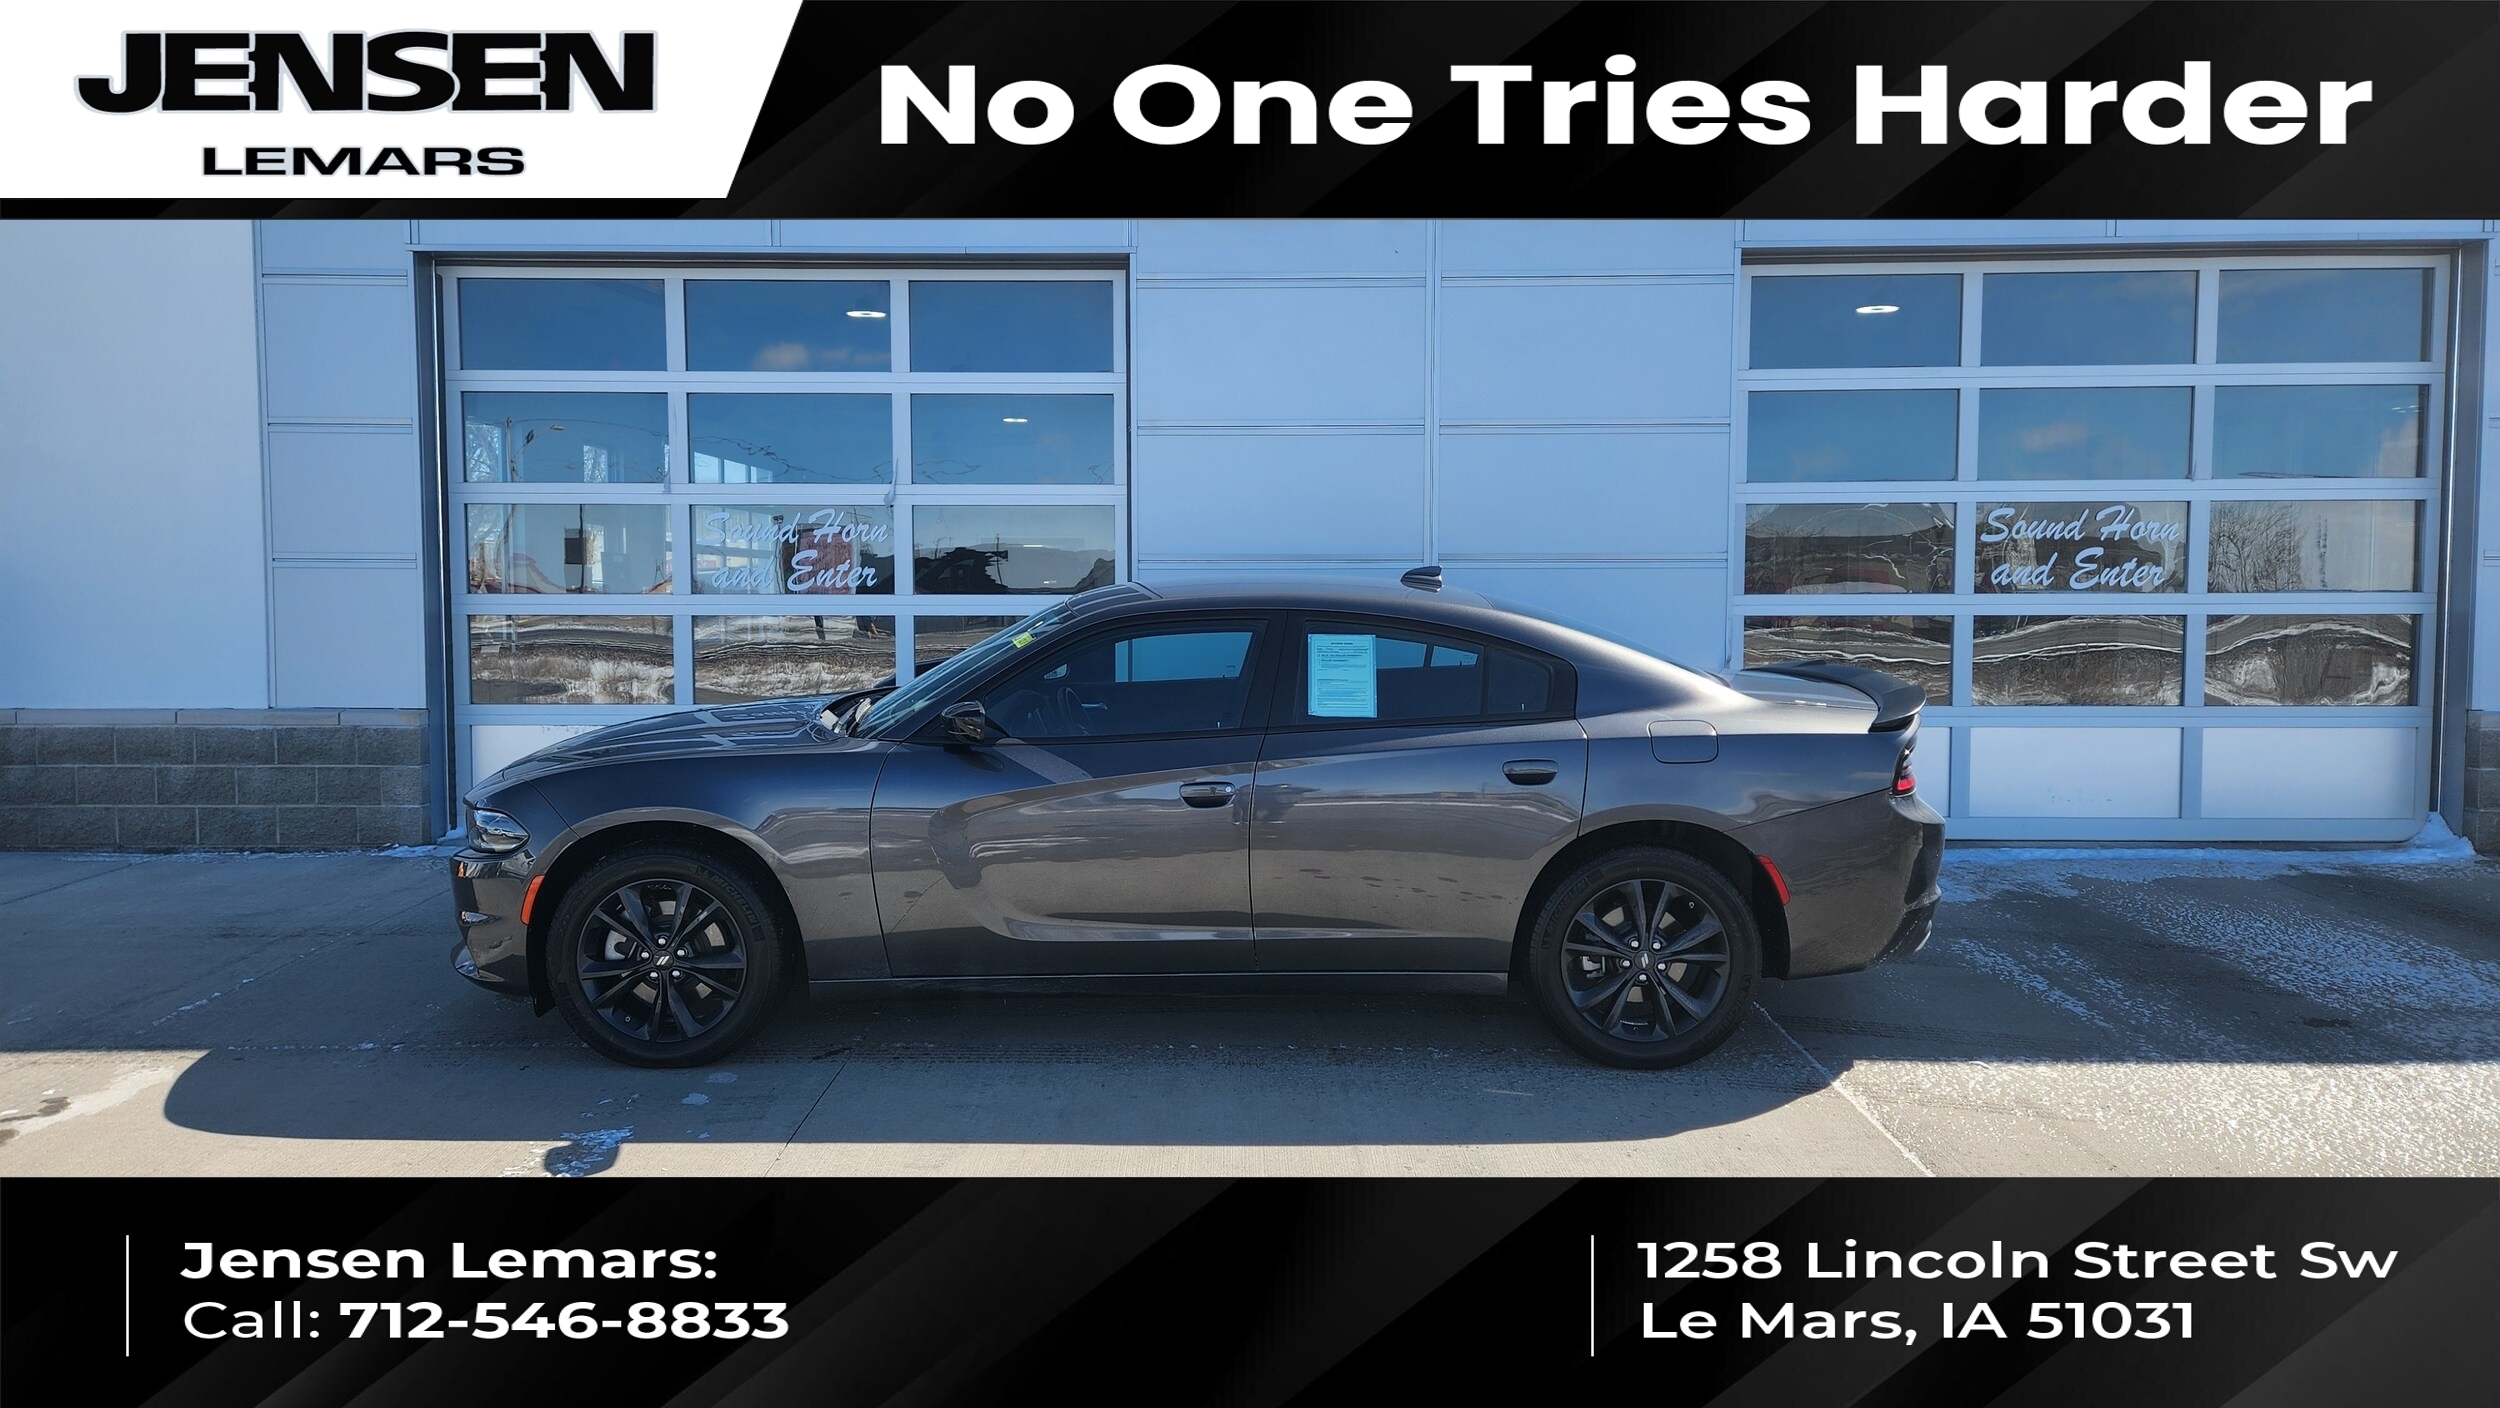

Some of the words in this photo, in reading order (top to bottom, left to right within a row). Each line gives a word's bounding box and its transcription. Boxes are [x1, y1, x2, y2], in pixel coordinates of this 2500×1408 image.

[696, 511, 801, 547] Sound
[808, 508, 888, 544] Horn
[1980, 507, 2090, 542] Sound
[2096, 505, 2180, 541] Horn
[711, 555, 775, 589] and
[787, 549, 878, 592] Enter
[1990, 552, 2059, 586] and
[2069, 546, 2165, 590] Enter
[710, 873, 760, 926] MICHELIN
